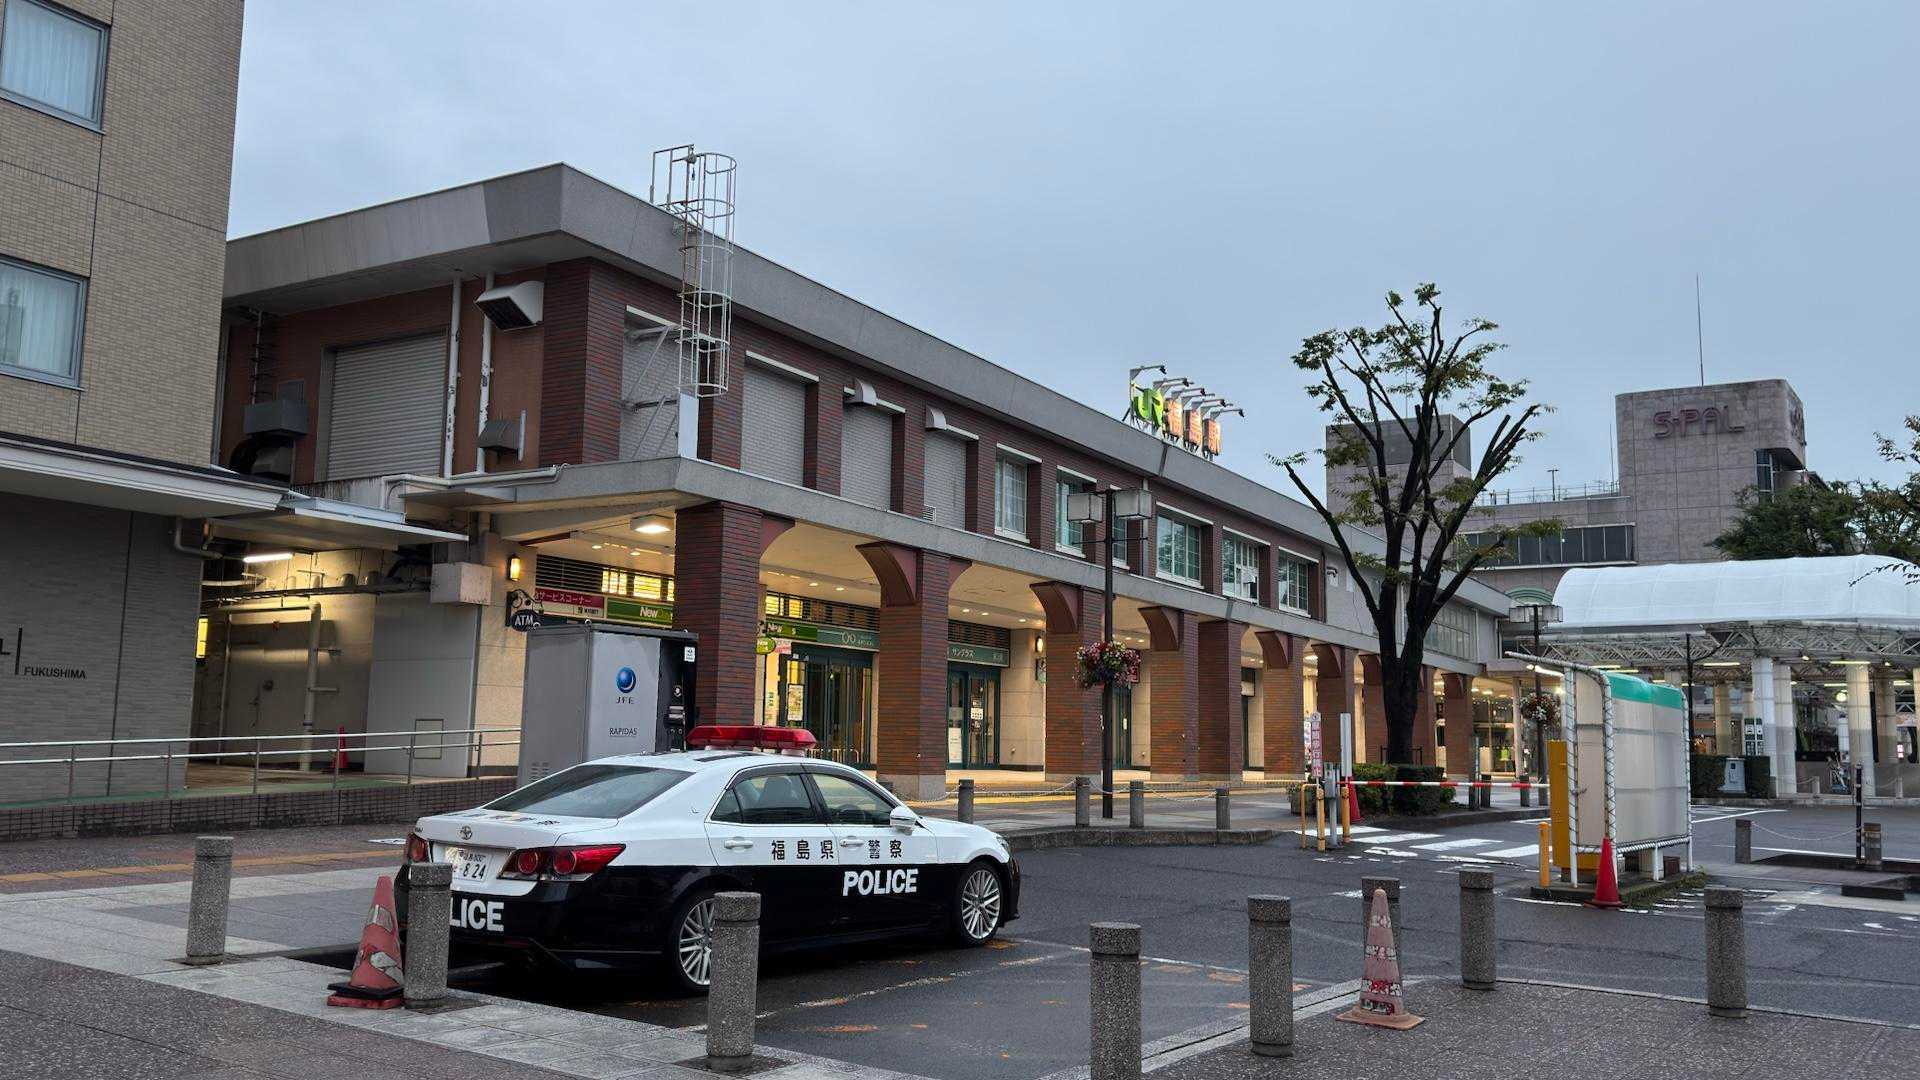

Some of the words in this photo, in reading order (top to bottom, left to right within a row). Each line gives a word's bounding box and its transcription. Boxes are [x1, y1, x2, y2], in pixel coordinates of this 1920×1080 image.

[514, 614, 534, 627] ATM
[24, 666, 87, 679] FUKUSHIMA
[609, 726, 638, 737] RAPIDAS
[771, 839, 835, 861] 福島県
[868, 839, 903, 859] 警察
[842, 868, 919, 896] POLICE
[450, 898, 505, 931] LICE
